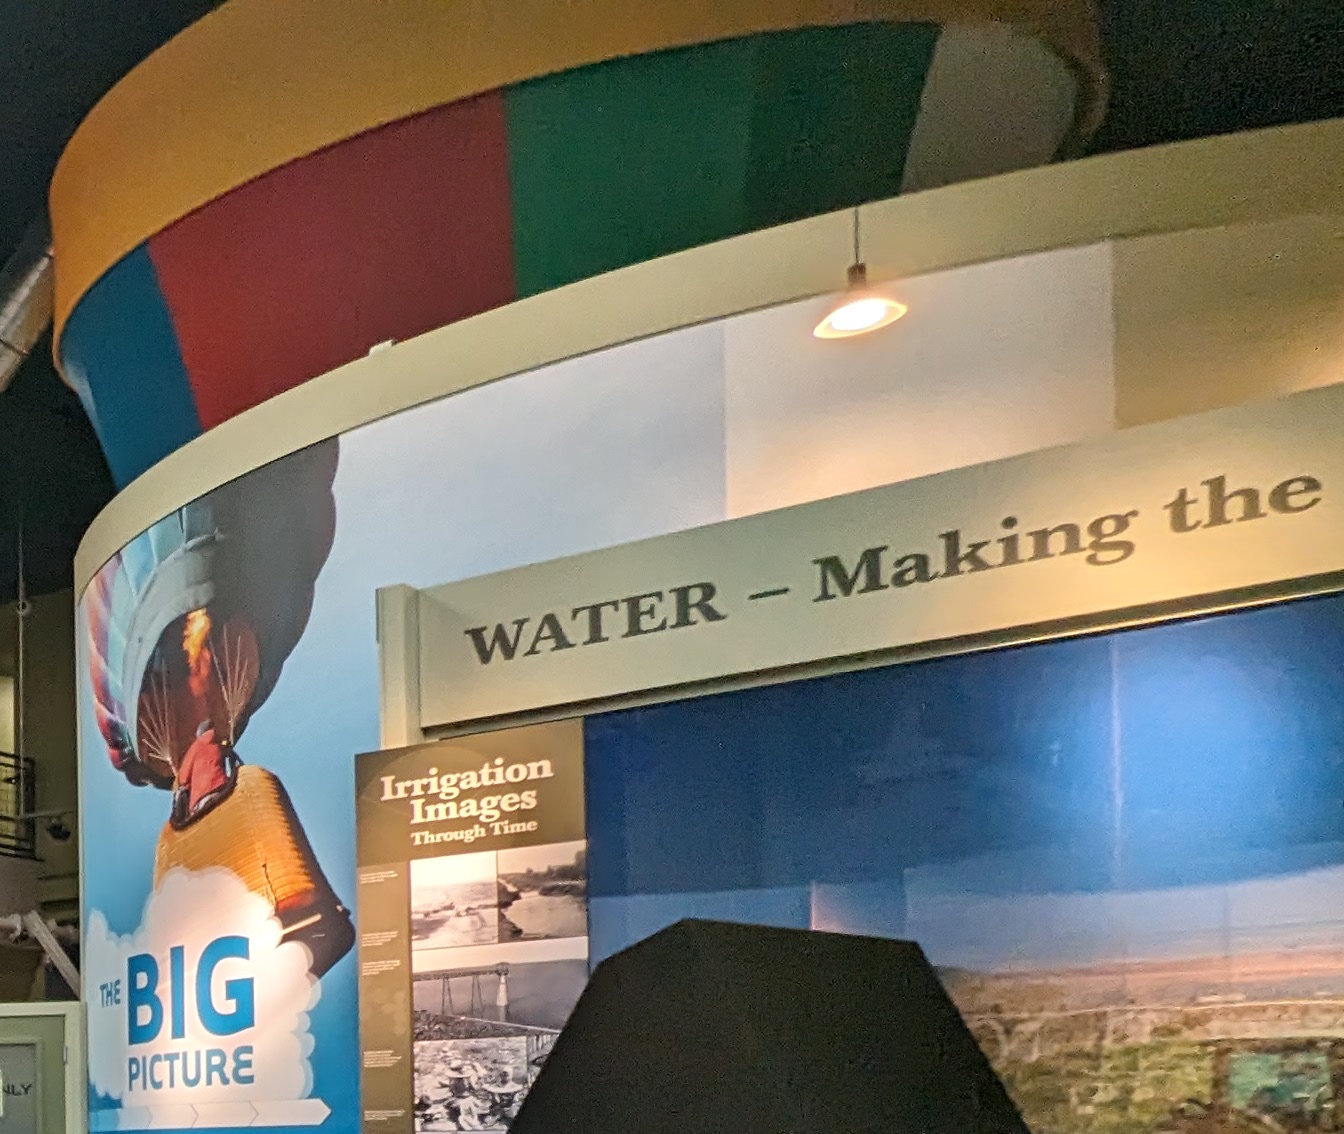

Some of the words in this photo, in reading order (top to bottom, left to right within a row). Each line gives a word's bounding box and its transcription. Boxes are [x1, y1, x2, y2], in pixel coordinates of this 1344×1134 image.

[465, 581, 727, 666] WATER
[812, 508, 1139, 604] Making
[1164, 474, 1324, 534] the
[380, 757, 554, 802] Irrigation
[410, 789, 537, 824] Images
[411, 824, 486, 846] Through
[490, 819, 538, 836] Time
[99, 978, 121, 1009] THE
[127, 935, 255, 1046] BIG
[2, 1082, 32, 1097] NLY
[128, 1045, 255, 1092] PICTURE
